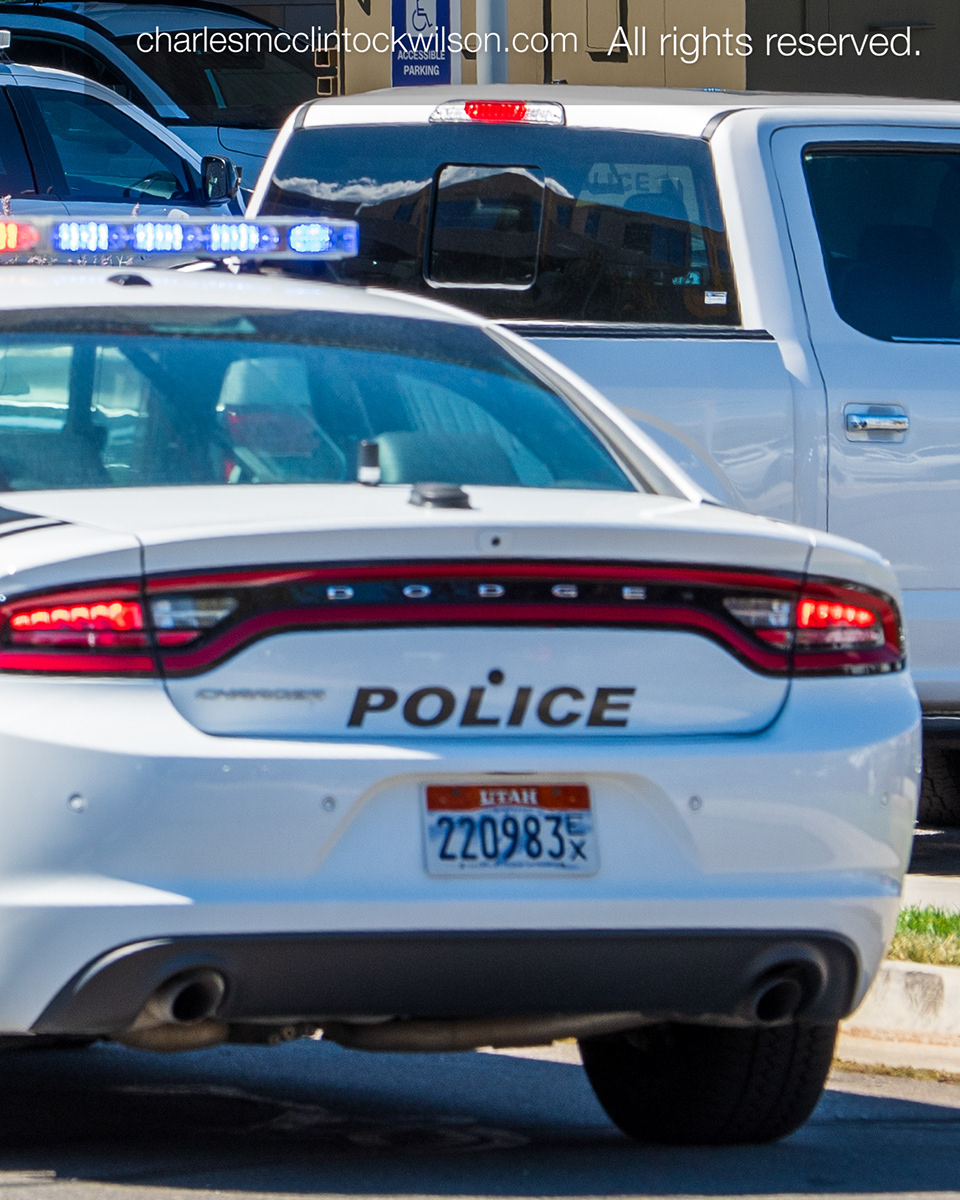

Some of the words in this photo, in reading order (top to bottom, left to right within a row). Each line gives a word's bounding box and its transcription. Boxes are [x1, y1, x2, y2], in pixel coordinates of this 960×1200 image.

[397, 49, 446, 60] ACCESSIBLE
[403, 64, 440, 76] PARKING
[326, 583, 648, 600] DODGE
[346, 685, 637, 728] POLICE
[478, 788, 538, 806] UTAH
[438, 815, 565, 861] 220983
